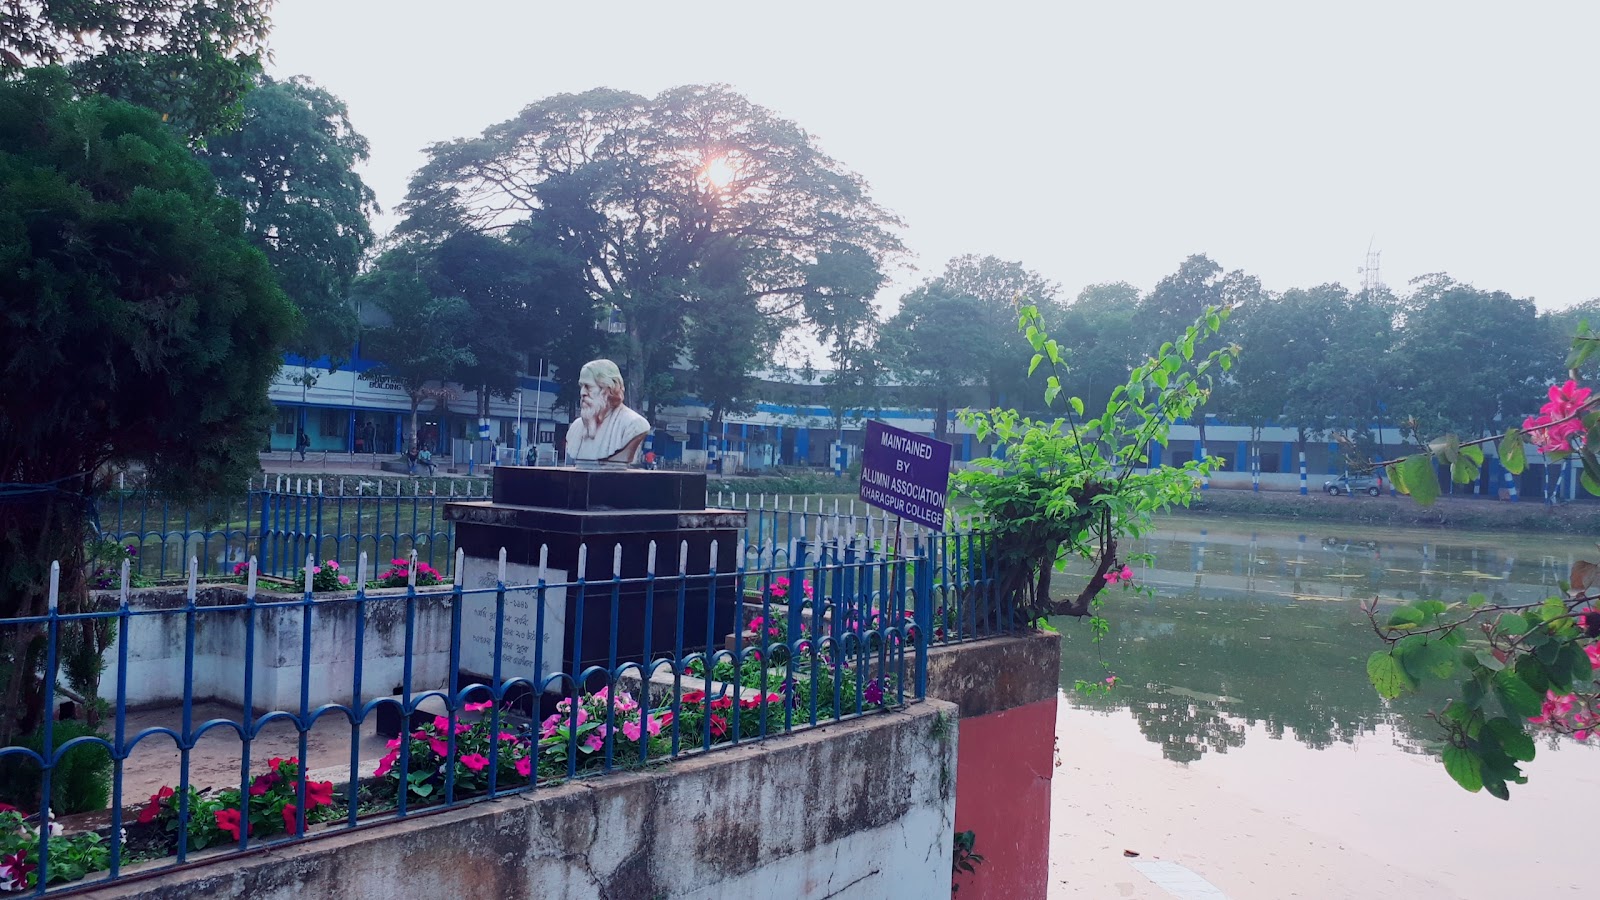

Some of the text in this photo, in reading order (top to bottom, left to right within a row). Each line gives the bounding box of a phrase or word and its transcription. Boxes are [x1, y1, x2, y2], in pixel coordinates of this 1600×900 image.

[369, 382, 401, 390] BUILDING
[881, 432, 932, 460] MAINTAINED
[896, 459, 911, 473] BY
[862, 467, 946, 509] ALUMNI ASSOCIATION
[861, 485, 943, 526] KHARAGPUR COLLEGE
